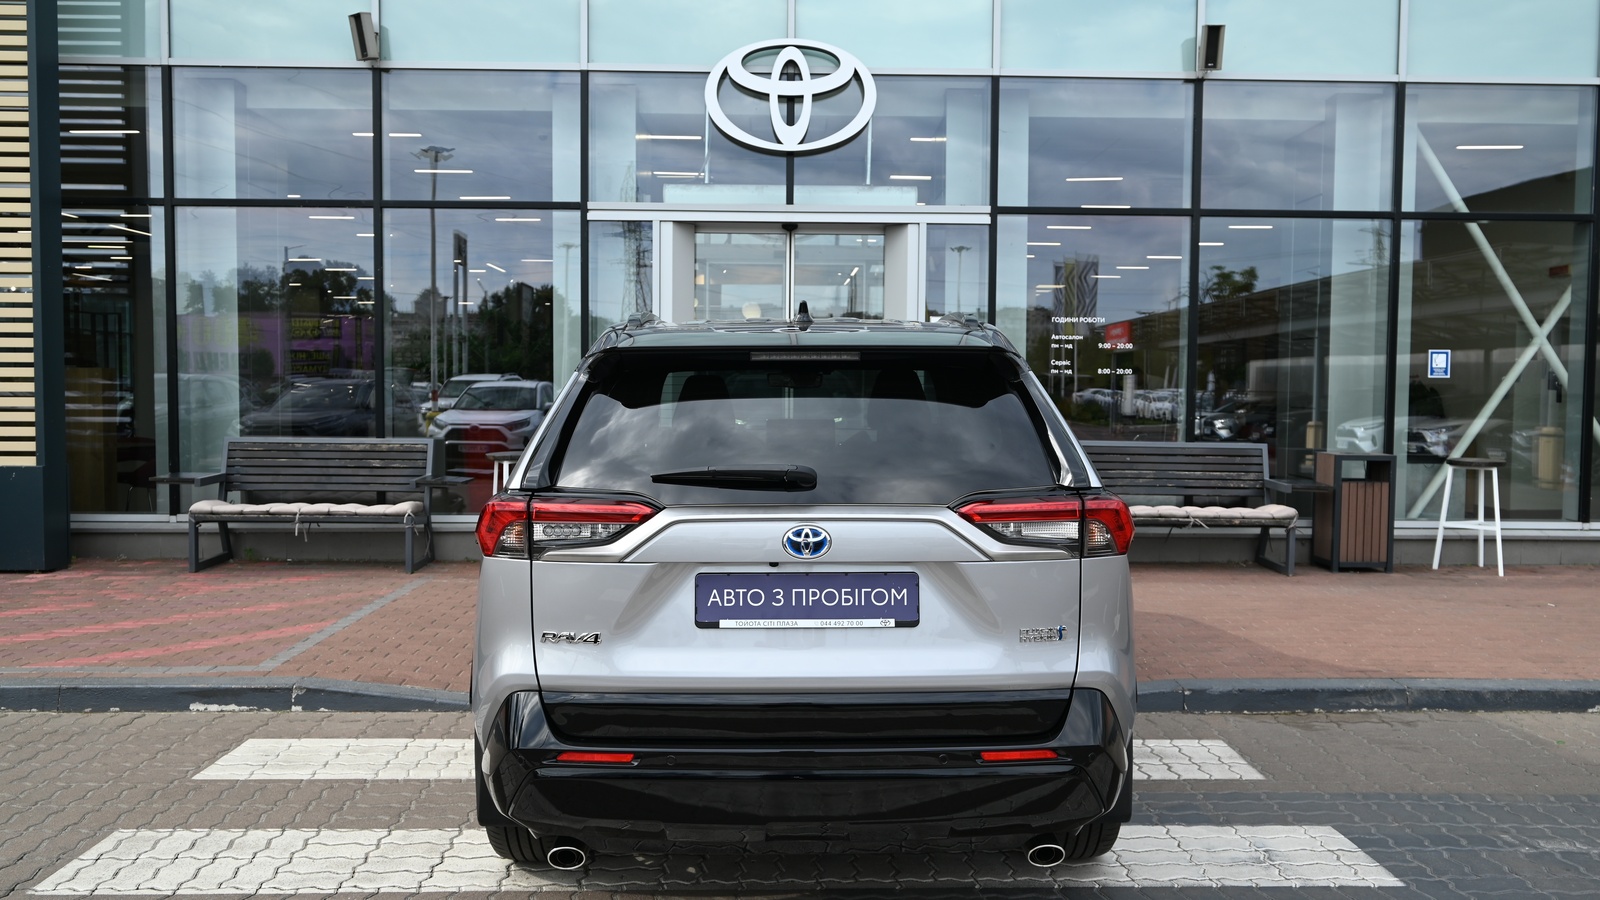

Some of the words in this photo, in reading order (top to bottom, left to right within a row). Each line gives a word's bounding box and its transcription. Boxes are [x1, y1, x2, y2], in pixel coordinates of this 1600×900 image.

[708, 588, 765, 607] АВТО
[792, 588, 908, 607] ПРОБІГОМ
[540, 630, 602, 645] RAV4
